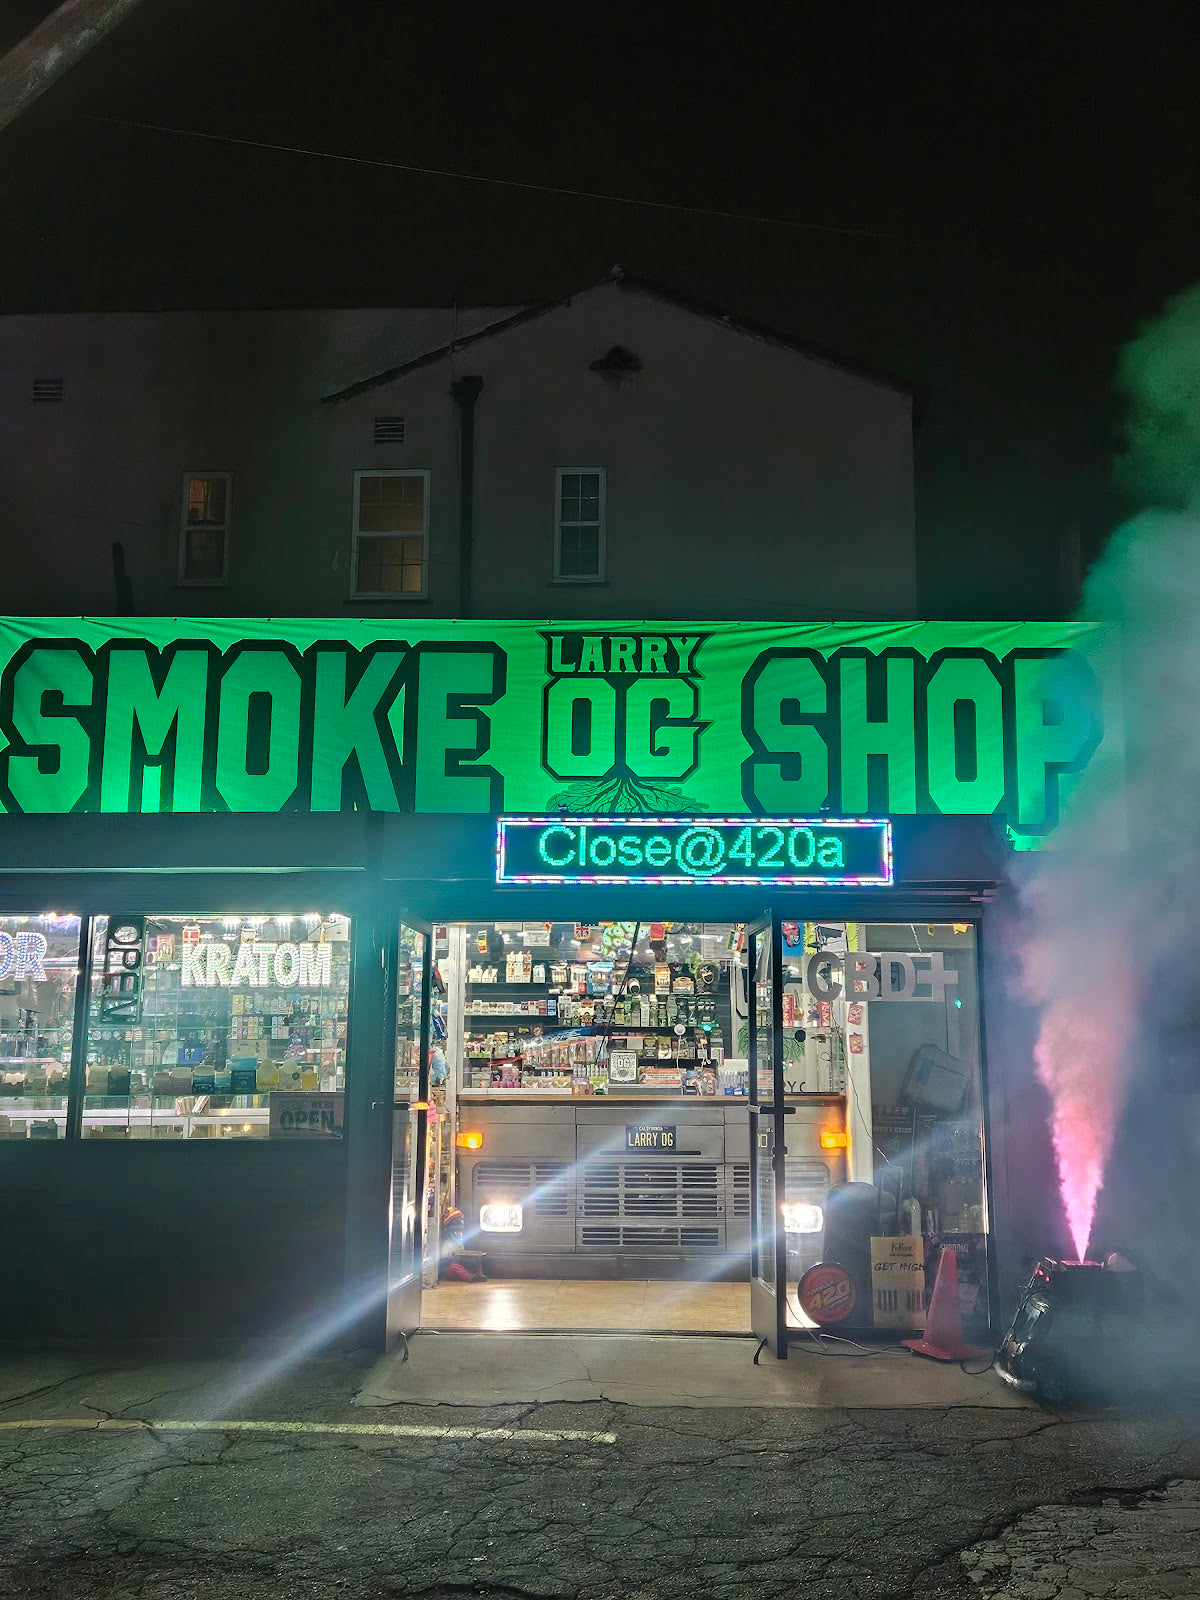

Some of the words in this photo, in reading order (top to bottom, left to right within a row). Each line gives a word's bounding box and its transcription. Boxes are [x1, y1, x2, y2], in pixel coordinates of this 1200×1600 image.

[544, 633, 706, 676] LARRY
[3, 638, 506, 813] SMOKE
[741, 647, 1104, 833] SHOP
[544, 677, 706, 781] OG
[538, 825, 846, 876] Close@420a
[181, 942, 333, 988] KRATOM
[280, 1111, 335, 1130] OPEN
[628, 1133, 657, 1146] LARRY
[661, 1133, 673, 1146] OG
[874, 1263, 896, 1271] GET
[808, 1280, 850, 1310] 420
